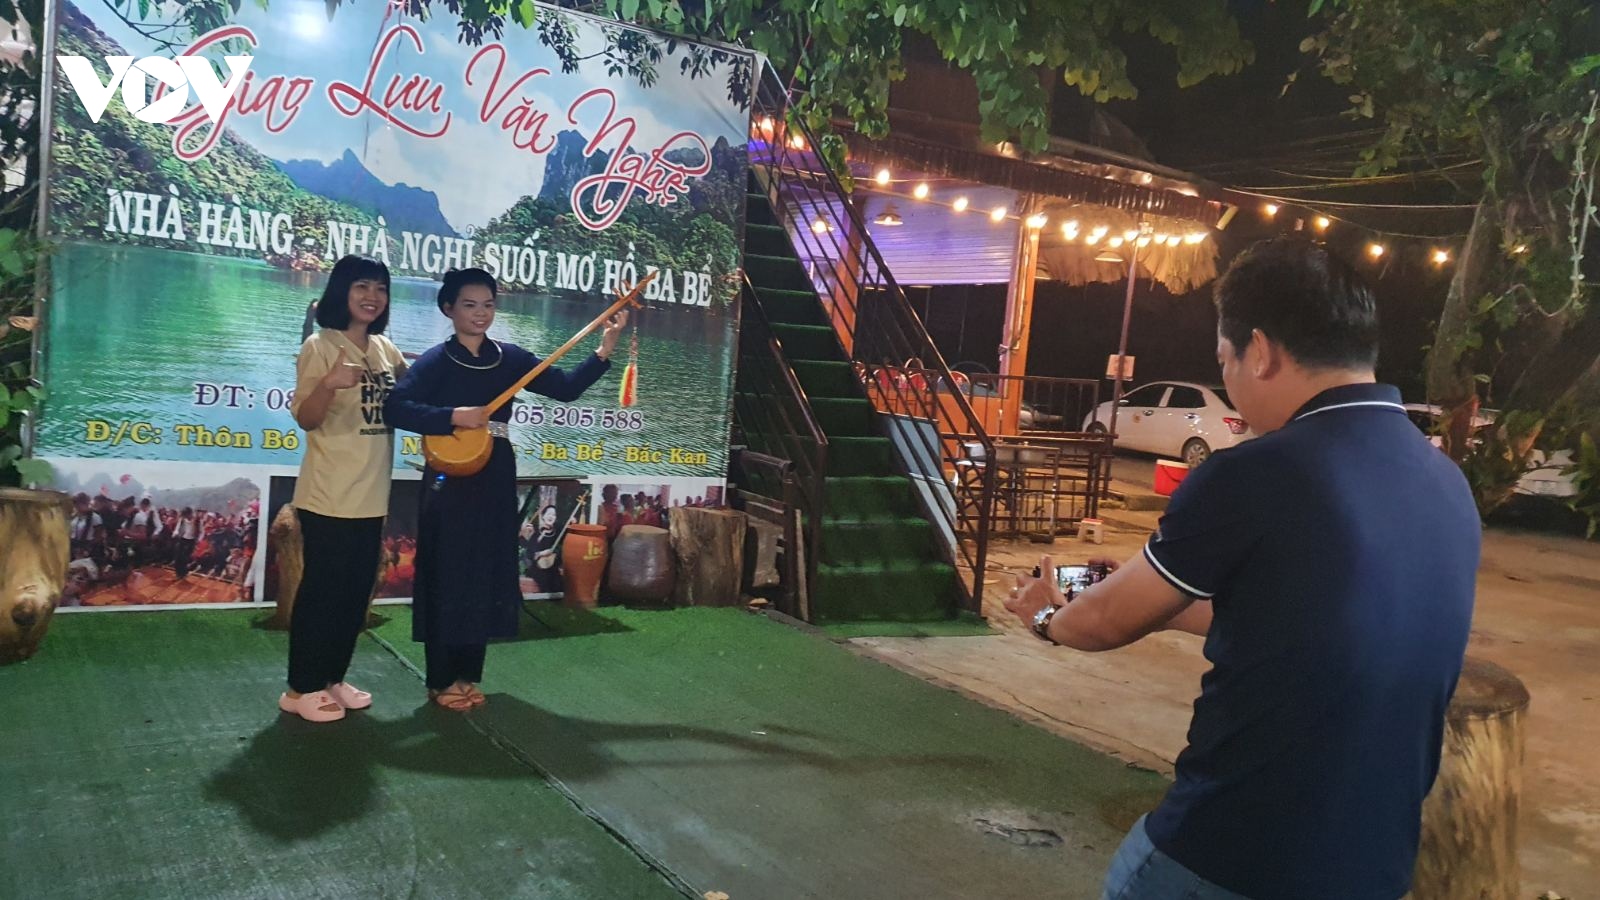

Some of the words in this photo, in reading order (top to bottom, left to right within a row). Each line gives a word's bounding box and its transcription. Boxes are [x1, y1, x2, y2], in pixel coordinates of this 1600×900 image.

[154, 26, 314, 159] Giao
[327, 25, 452, 138] Lưu
[465, 44, 557, 154] Văn
[567, 87, 712, 229] Nghệ
[106, 184, 187, 242] NHÀ
[197, 194, 296, 256] HÀNG
[324, 215, 391, 267] NHÀ
[400, 223, 475, 274] NGHỈ
[483, 230, 548, 286] SUỐI
[555, 250, 597, 293] MƠ
[601, 241, 637, 296] HỒ
[644, 265, 676, 303] BA
[681, 253, 713, 307] BỂ
[85, 420, 162, 446] Đ/C:
[175, 424, 252, 448] Thôn
[262, 429, 299, 450] Bó
[541, 442, 568, 461] Ba
[194, 383, 255, 409] ĐT:
[514, 404, 545, 425] 65
[552, 406, 594, 427] 205
[602, 410, 643, 430] 588
